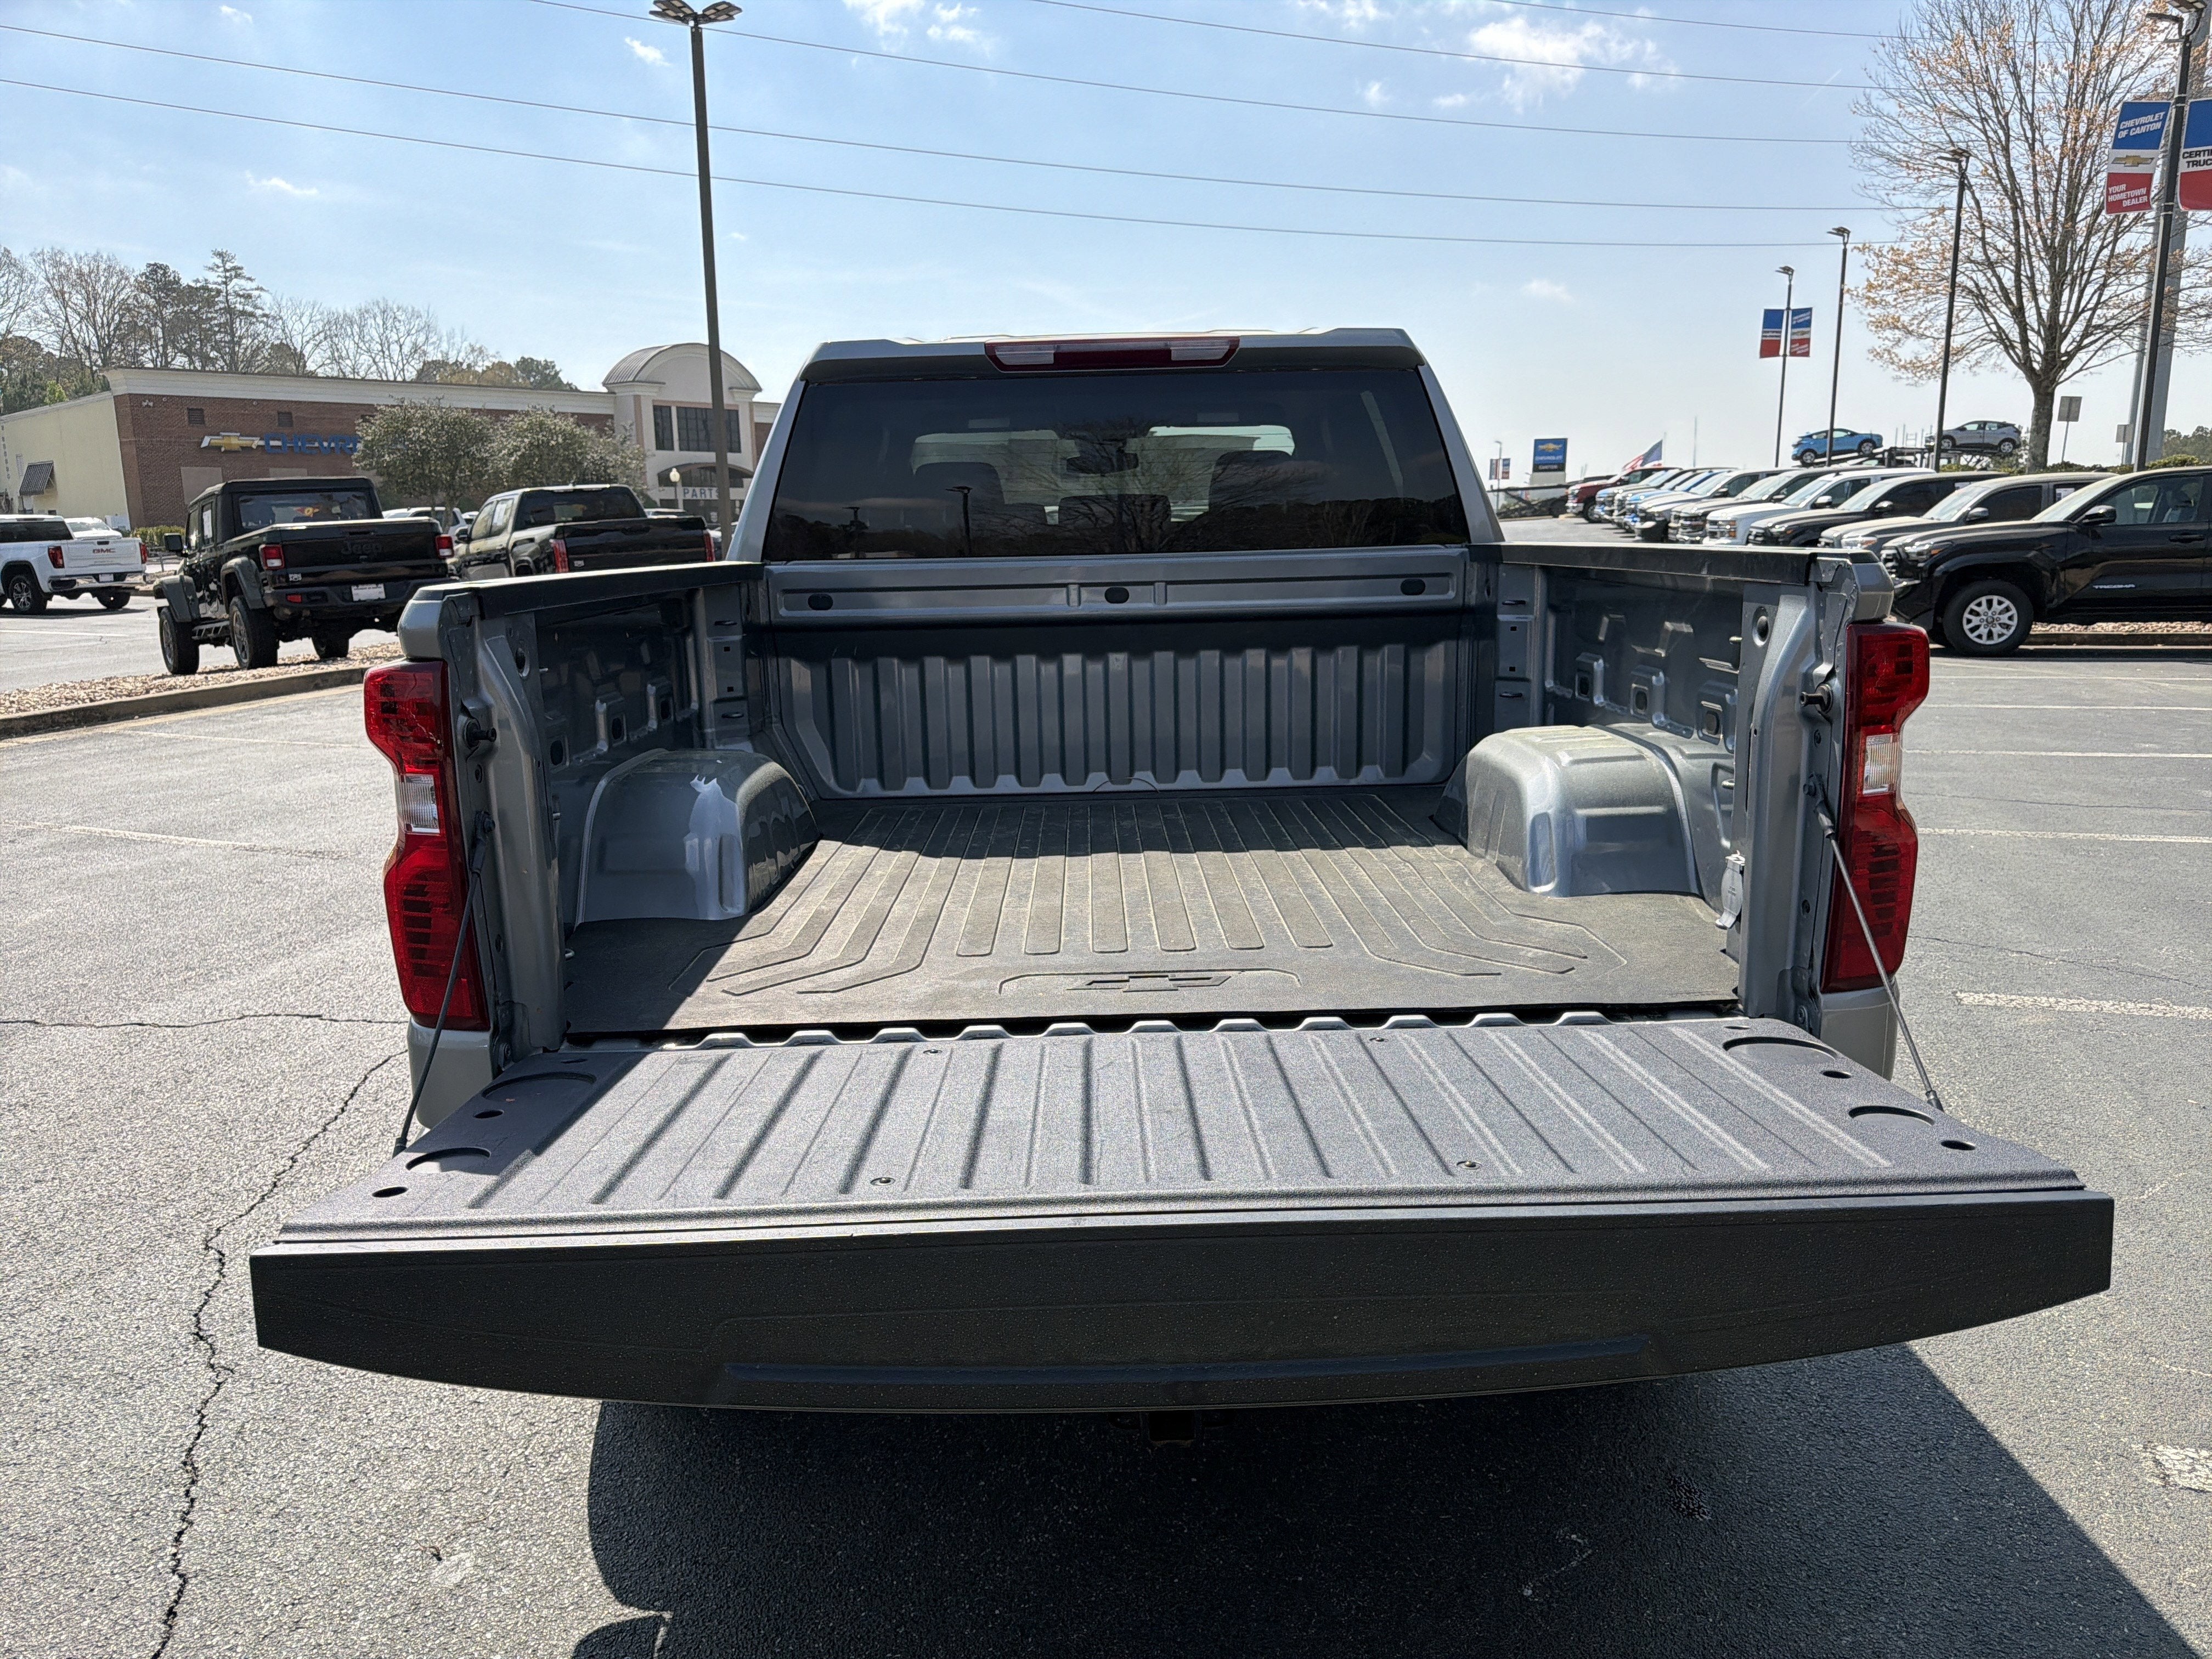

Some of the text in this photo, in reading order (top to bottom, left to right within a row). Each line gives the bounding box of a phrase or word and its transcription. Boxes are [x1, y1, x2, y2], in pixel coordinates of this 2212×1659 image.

[2120, 111, 2165, 129] CHEVROLET
[2118, 121, 2162, 139] OF CANTON
[2108, 184, 2126, 194] YOUR
[2108, 187, 2147, 202] HOMETOWN
[2122, 195, 2148, 207] DEALER
[341, 541, 382, 558] Jeep
